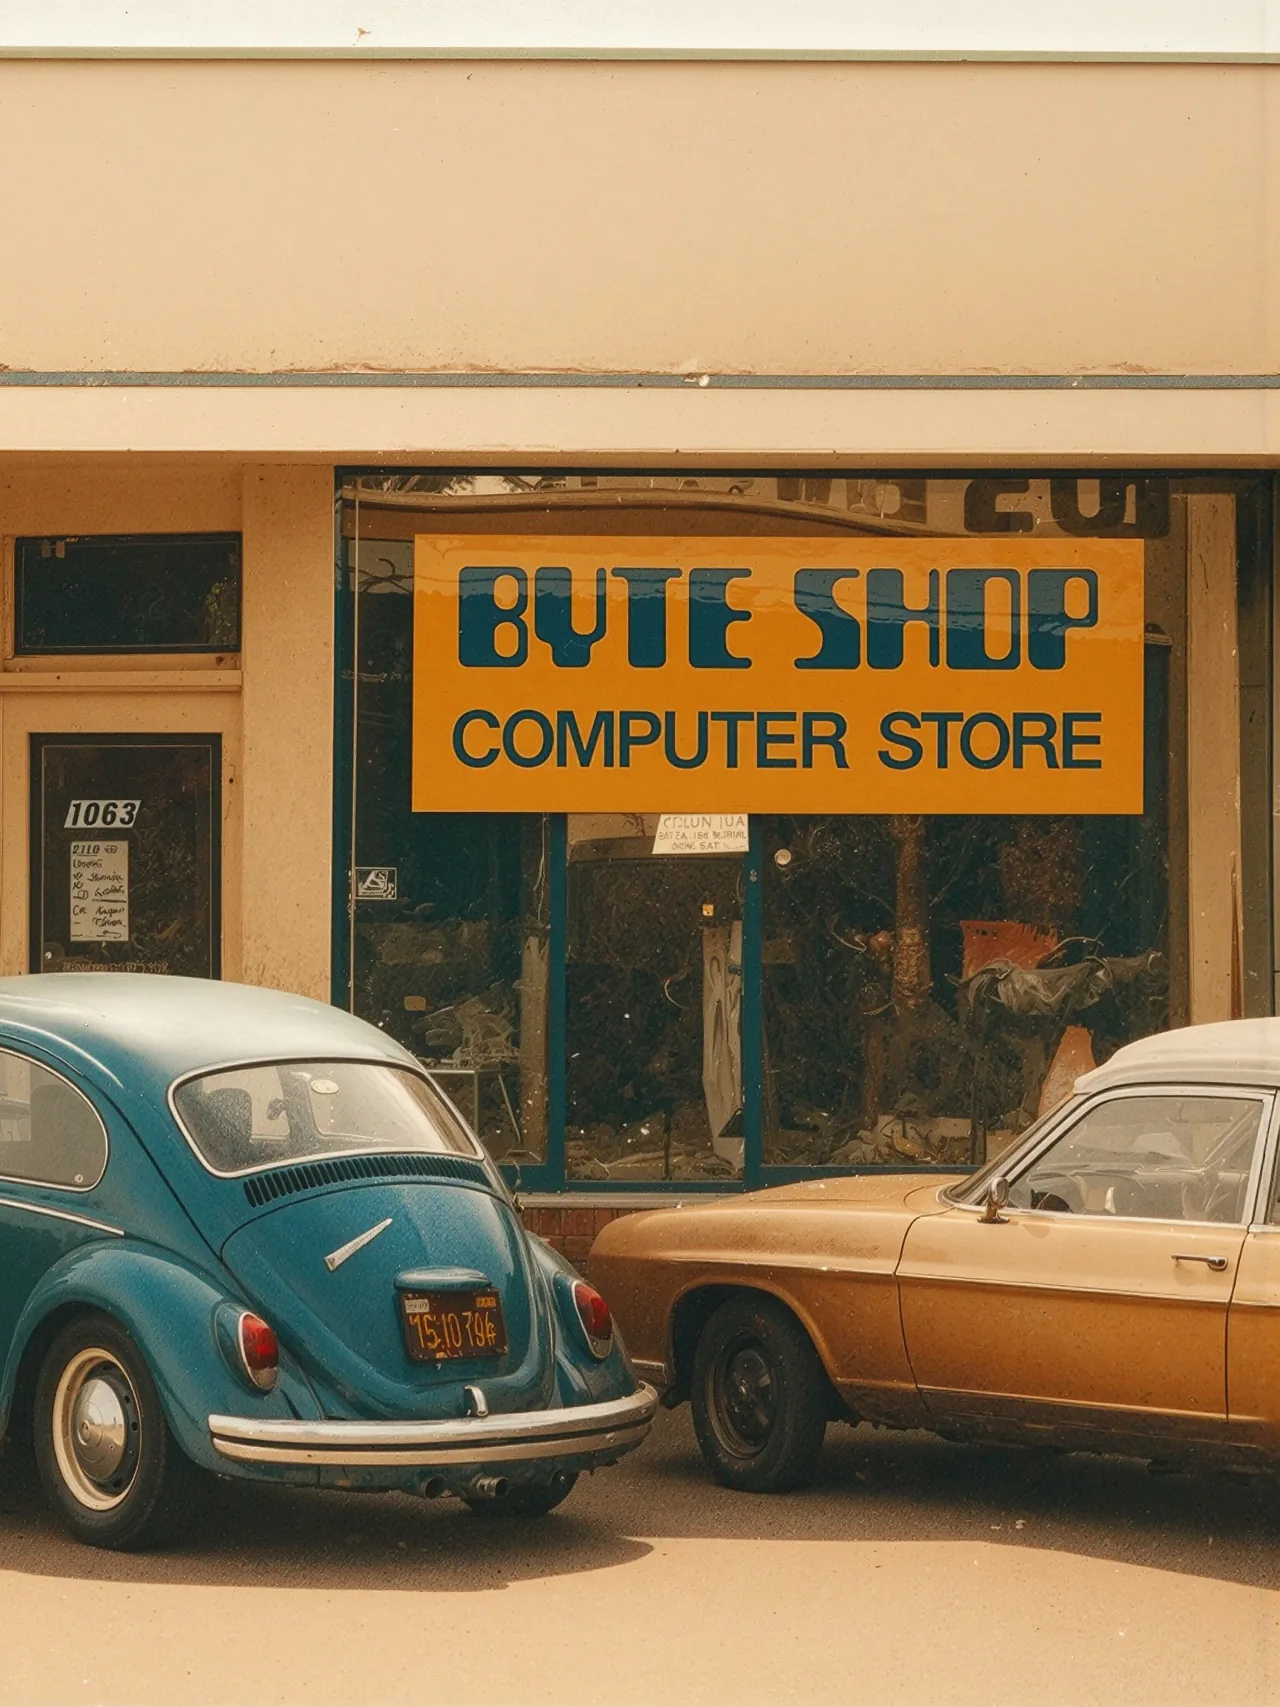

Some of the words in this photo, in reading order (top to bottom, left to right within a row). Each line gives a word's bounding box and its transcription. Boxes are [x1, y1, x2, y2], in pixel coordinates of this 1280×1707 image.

[459, 567, 752, 668] BYTE
[794, 569, 1098, 670] SHOP
[453, 710, 848, 768] COMPUTER
[879, 712, 1101, 769] STORE
[71, 802, 137, 826] 1063
